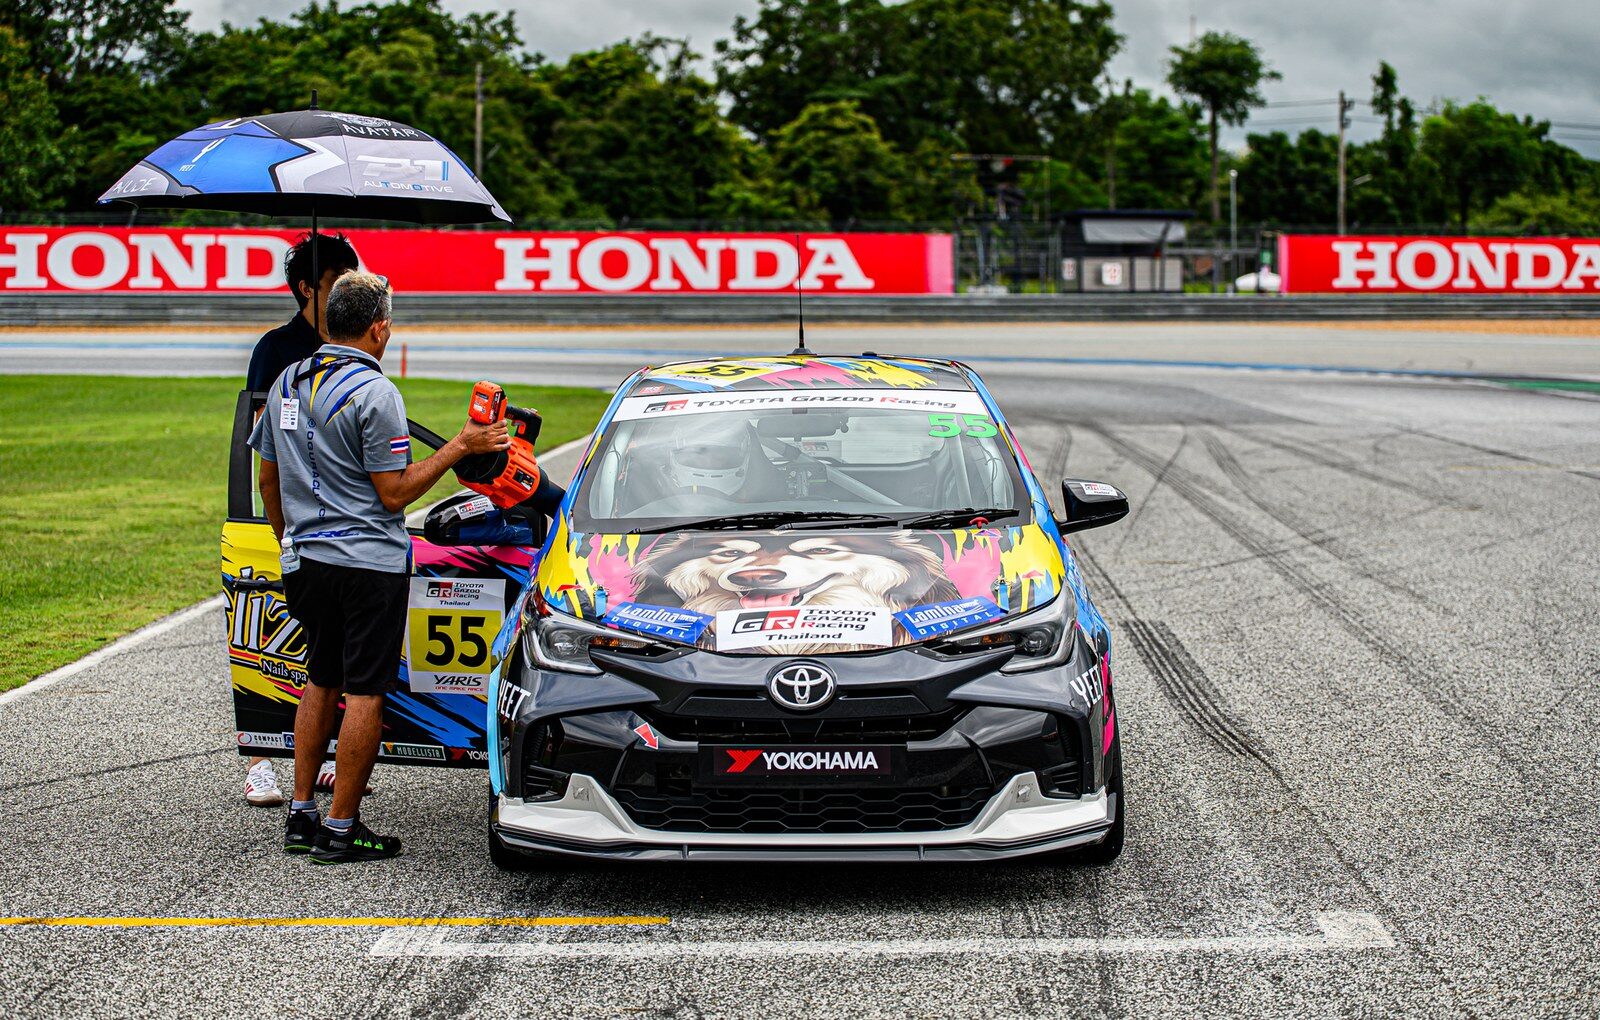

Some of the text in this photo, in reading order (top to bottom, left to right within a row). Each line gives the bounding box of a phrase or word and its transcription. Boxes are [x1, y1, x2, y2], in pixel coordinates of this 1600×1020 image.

[342, 123, 419, 138] AVATAR
[363, 180, 454, 193] AUTOMOTIVE
[495, 236, 875, 291] HONDA
[693, 397, 784, 408] TOYOTA
[880, 397, 956, 408] Racing
[928, 414, 998, 438] 55
[427, 587, 451, 598] GR
[611, 615, 685, 638] DIGITAL
[734, 616, 795, 633] GR
[801, 621, 866, 631] Racing
[918, 611, 993, 635] DIGITAL
[425, 615, 488, 667] 55
[765, 632, 843, 641] Thailand
[262, 660, 307, 684] Nails spa
[498, 678, 531, 721] YEET
[254, 735, 282, 743] COMPACT
[397, 746, 440, 758] MODELLISTA
[762, 752, 879, 770] YOKOHAMA
